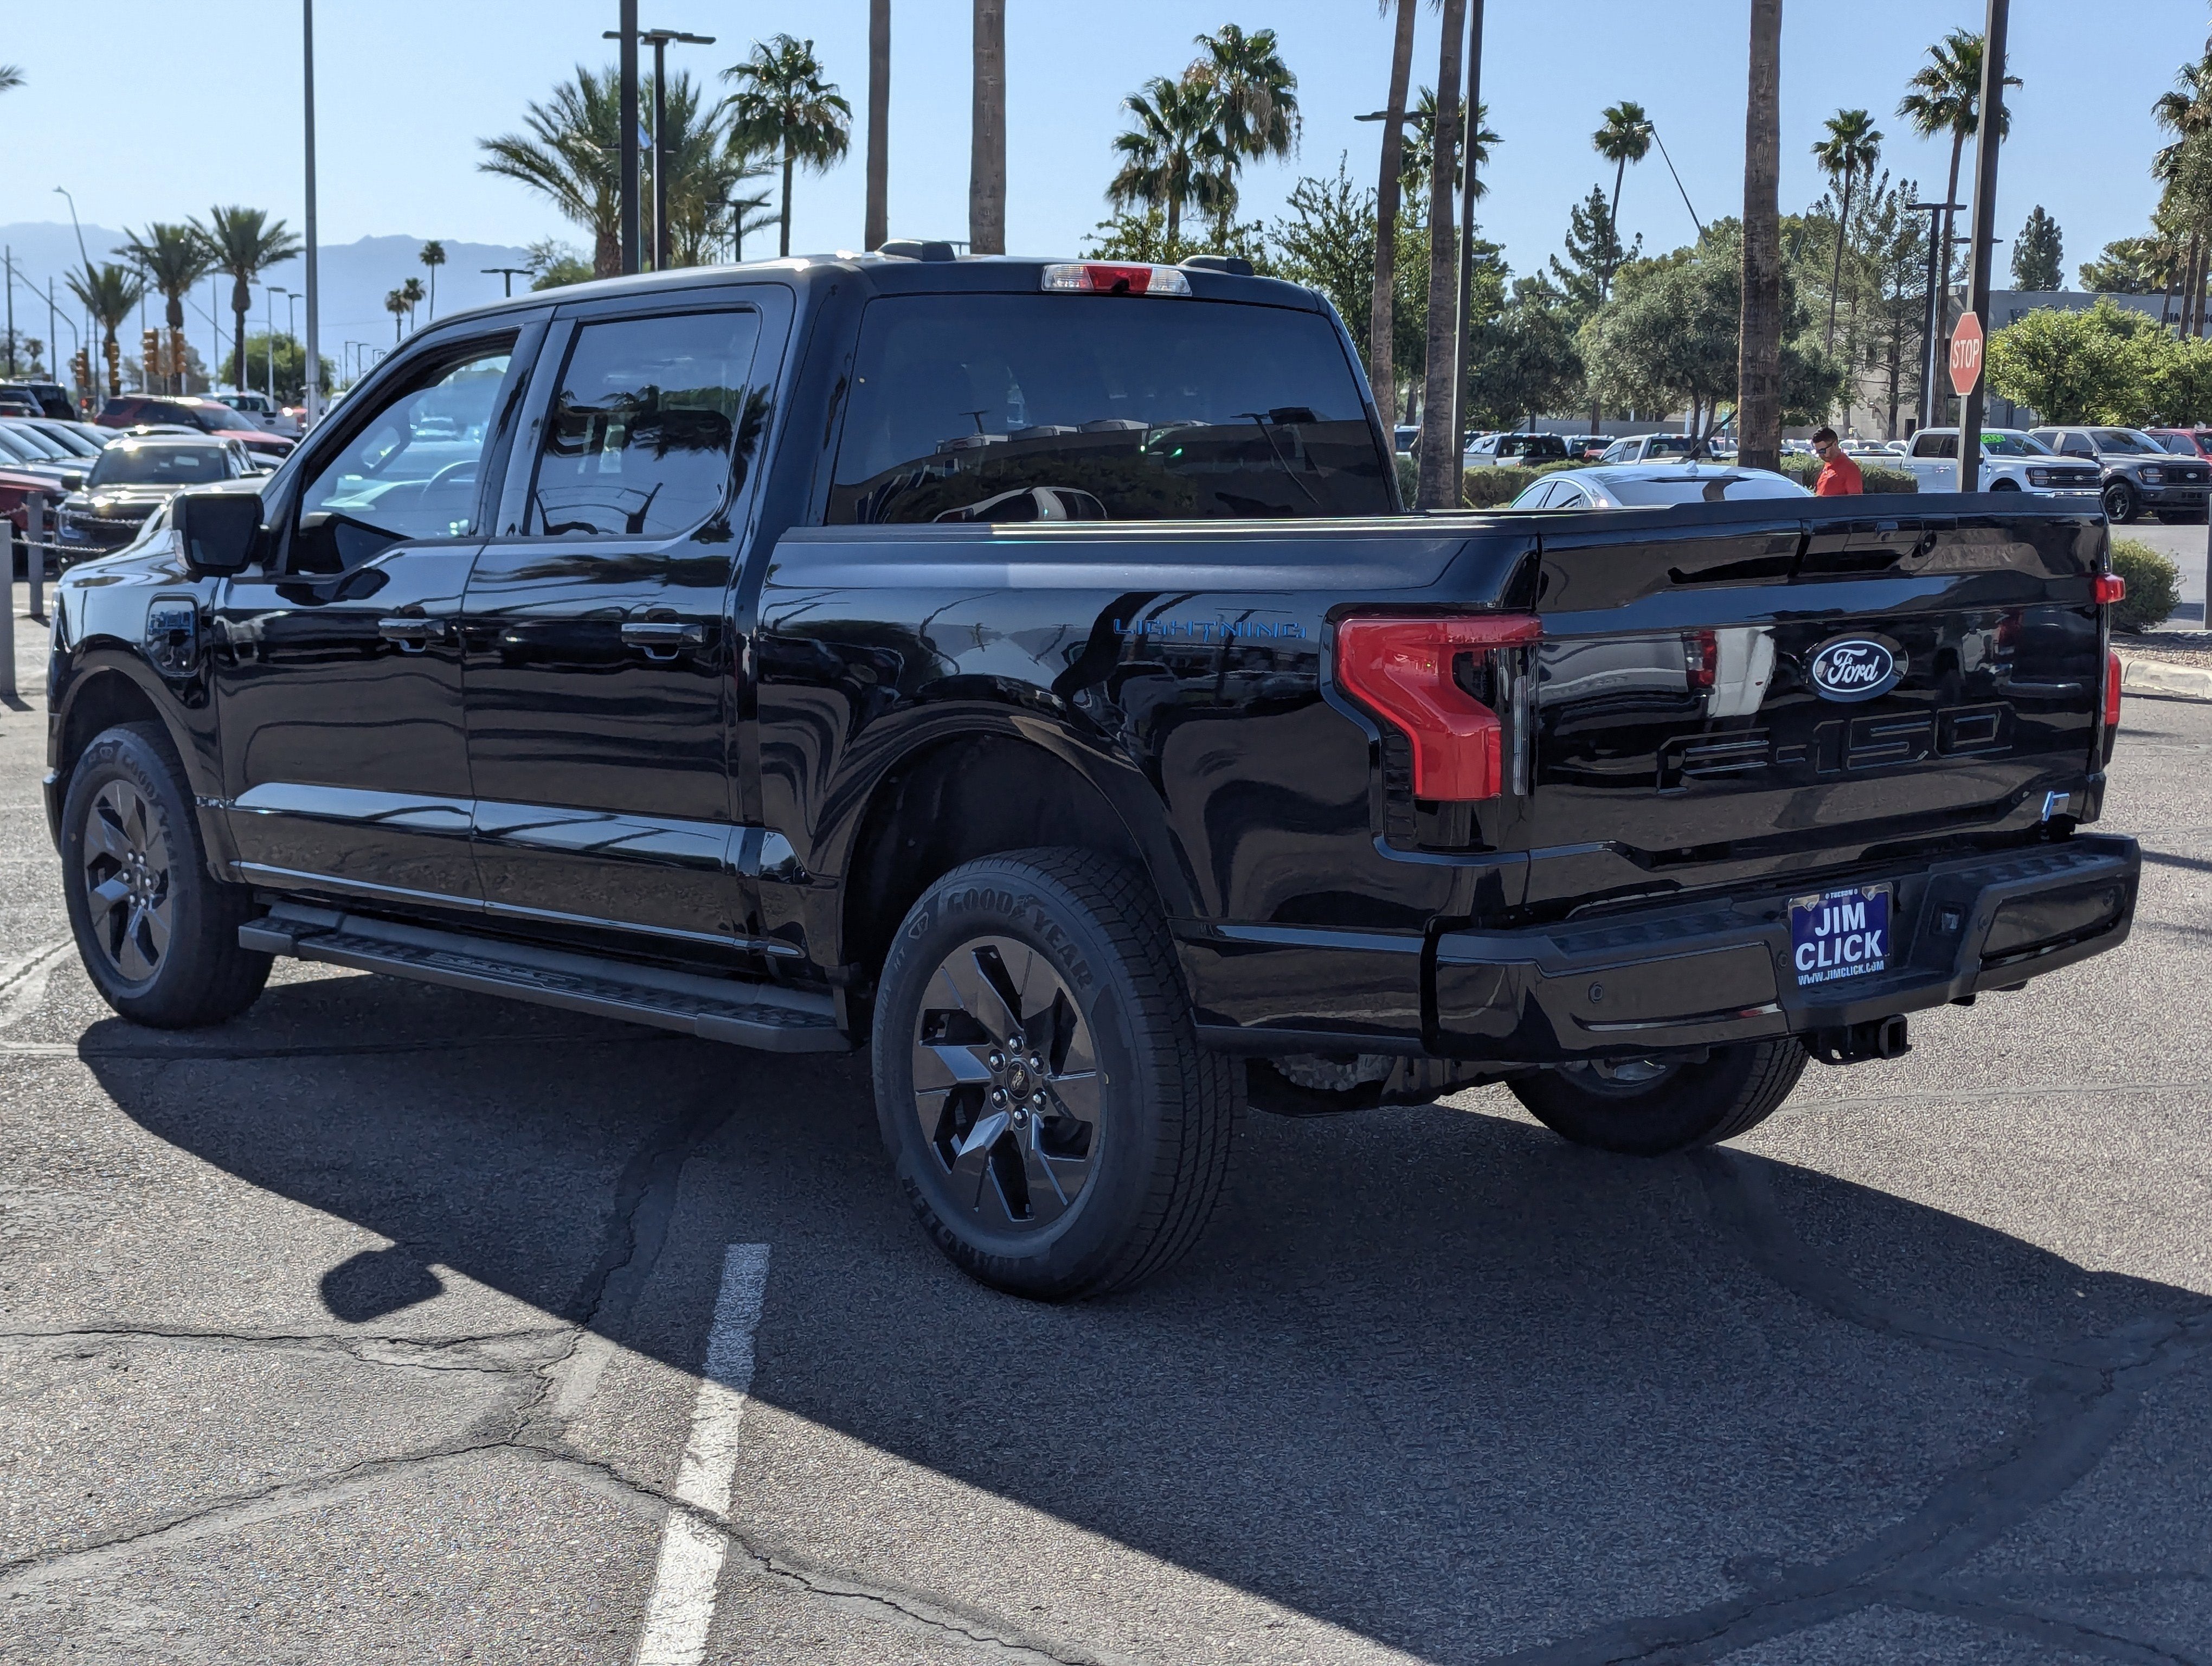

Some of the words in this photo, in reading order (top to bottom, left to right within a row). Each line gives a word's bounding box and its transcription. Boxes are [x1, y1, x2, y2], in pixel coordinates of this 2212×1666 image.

[1952, 338, 1980, 369] STOP
[1113, 618, 1307, 642] LIGHTNING
[1827, 648, 1880, 684] Ford
[1656, 701, 2015, 794] F-150
[1815, 901, 1866, 937] JIM
[1795, 929, 1883, 971] CLICK
[1798, 959, 1885, 986] WWW.JIMCLICK.COM
